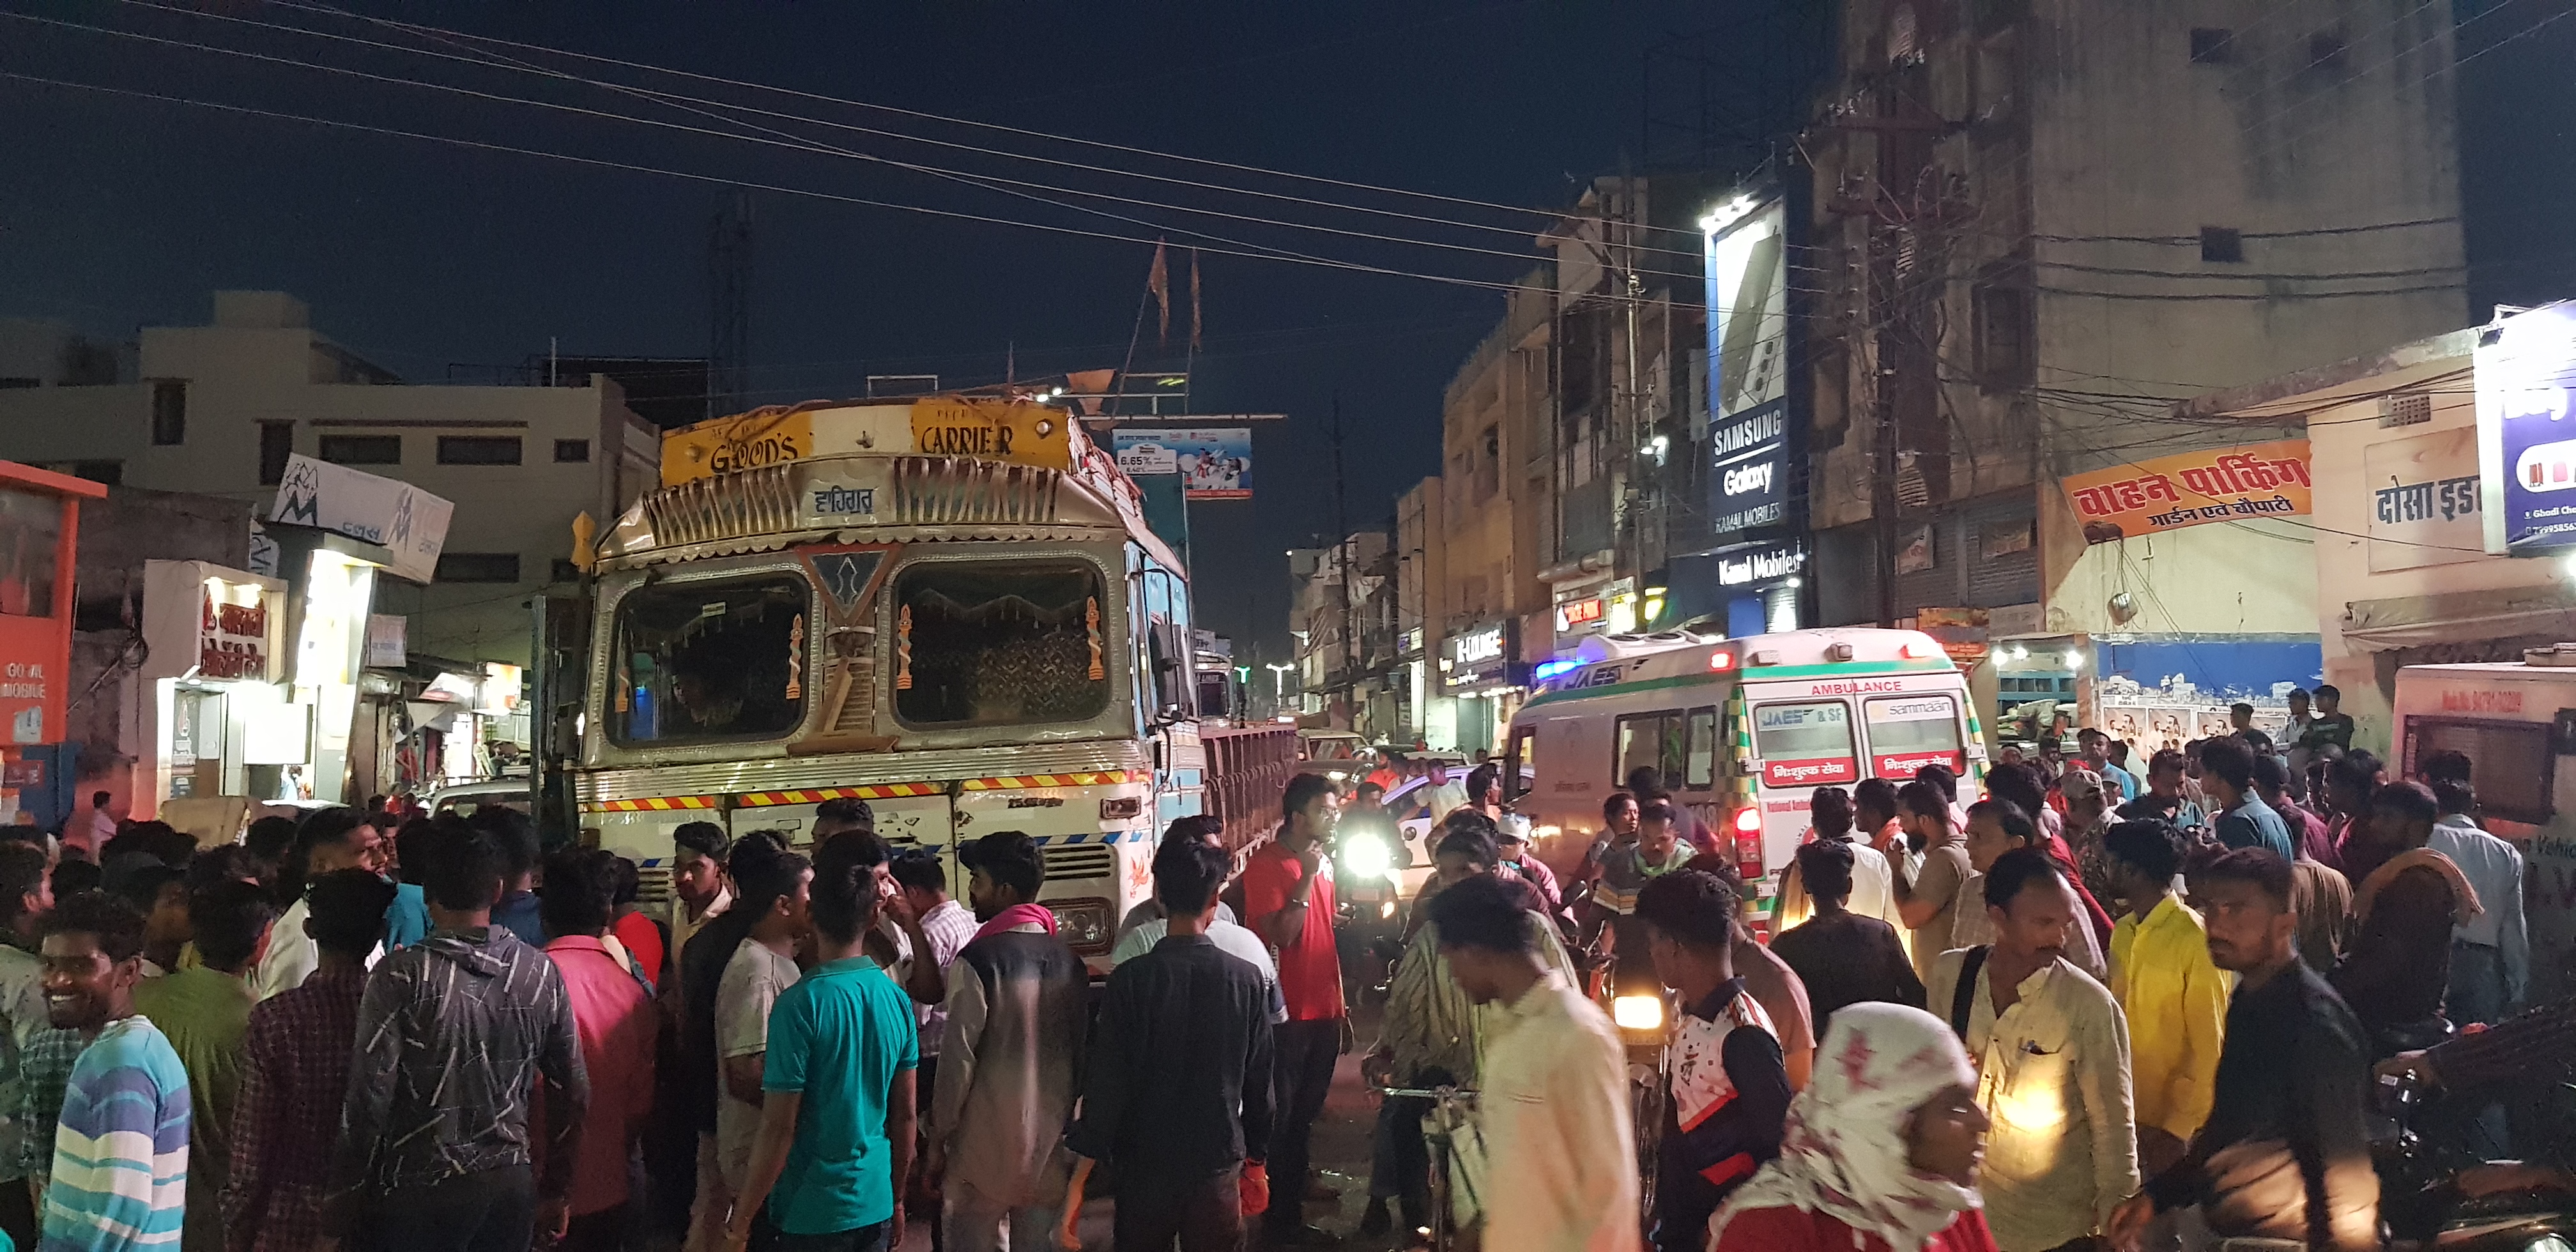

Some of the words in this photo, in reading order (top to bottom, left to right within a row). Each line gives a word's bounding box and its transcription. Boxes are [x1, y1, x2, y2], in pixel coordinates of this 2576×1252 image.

[921, 425, 1013, 455] CARRIER
[1714, 409, 1782, 456] SAMSUNG
[1724, 462, 1773, 495] Galaxy
[2073, 474, 2181, 517] वाहन
[2147, 506, 2199, 526] गार्डन
[2232, 495, 2296, 515] चौपाटी
[2375, 475, 2435, 524] दोसा
[1744, 502, 1780, 528] MOBILES
[1718, 554, 1752, 586] Kamal
[1753, 549, 1797, 580] Mobiles
[1811, 681, 1903, 696] AMBULANCE
[1821, 762, 1845, 775] सेवा
[1930, 755, 1953, 768] सेवा
